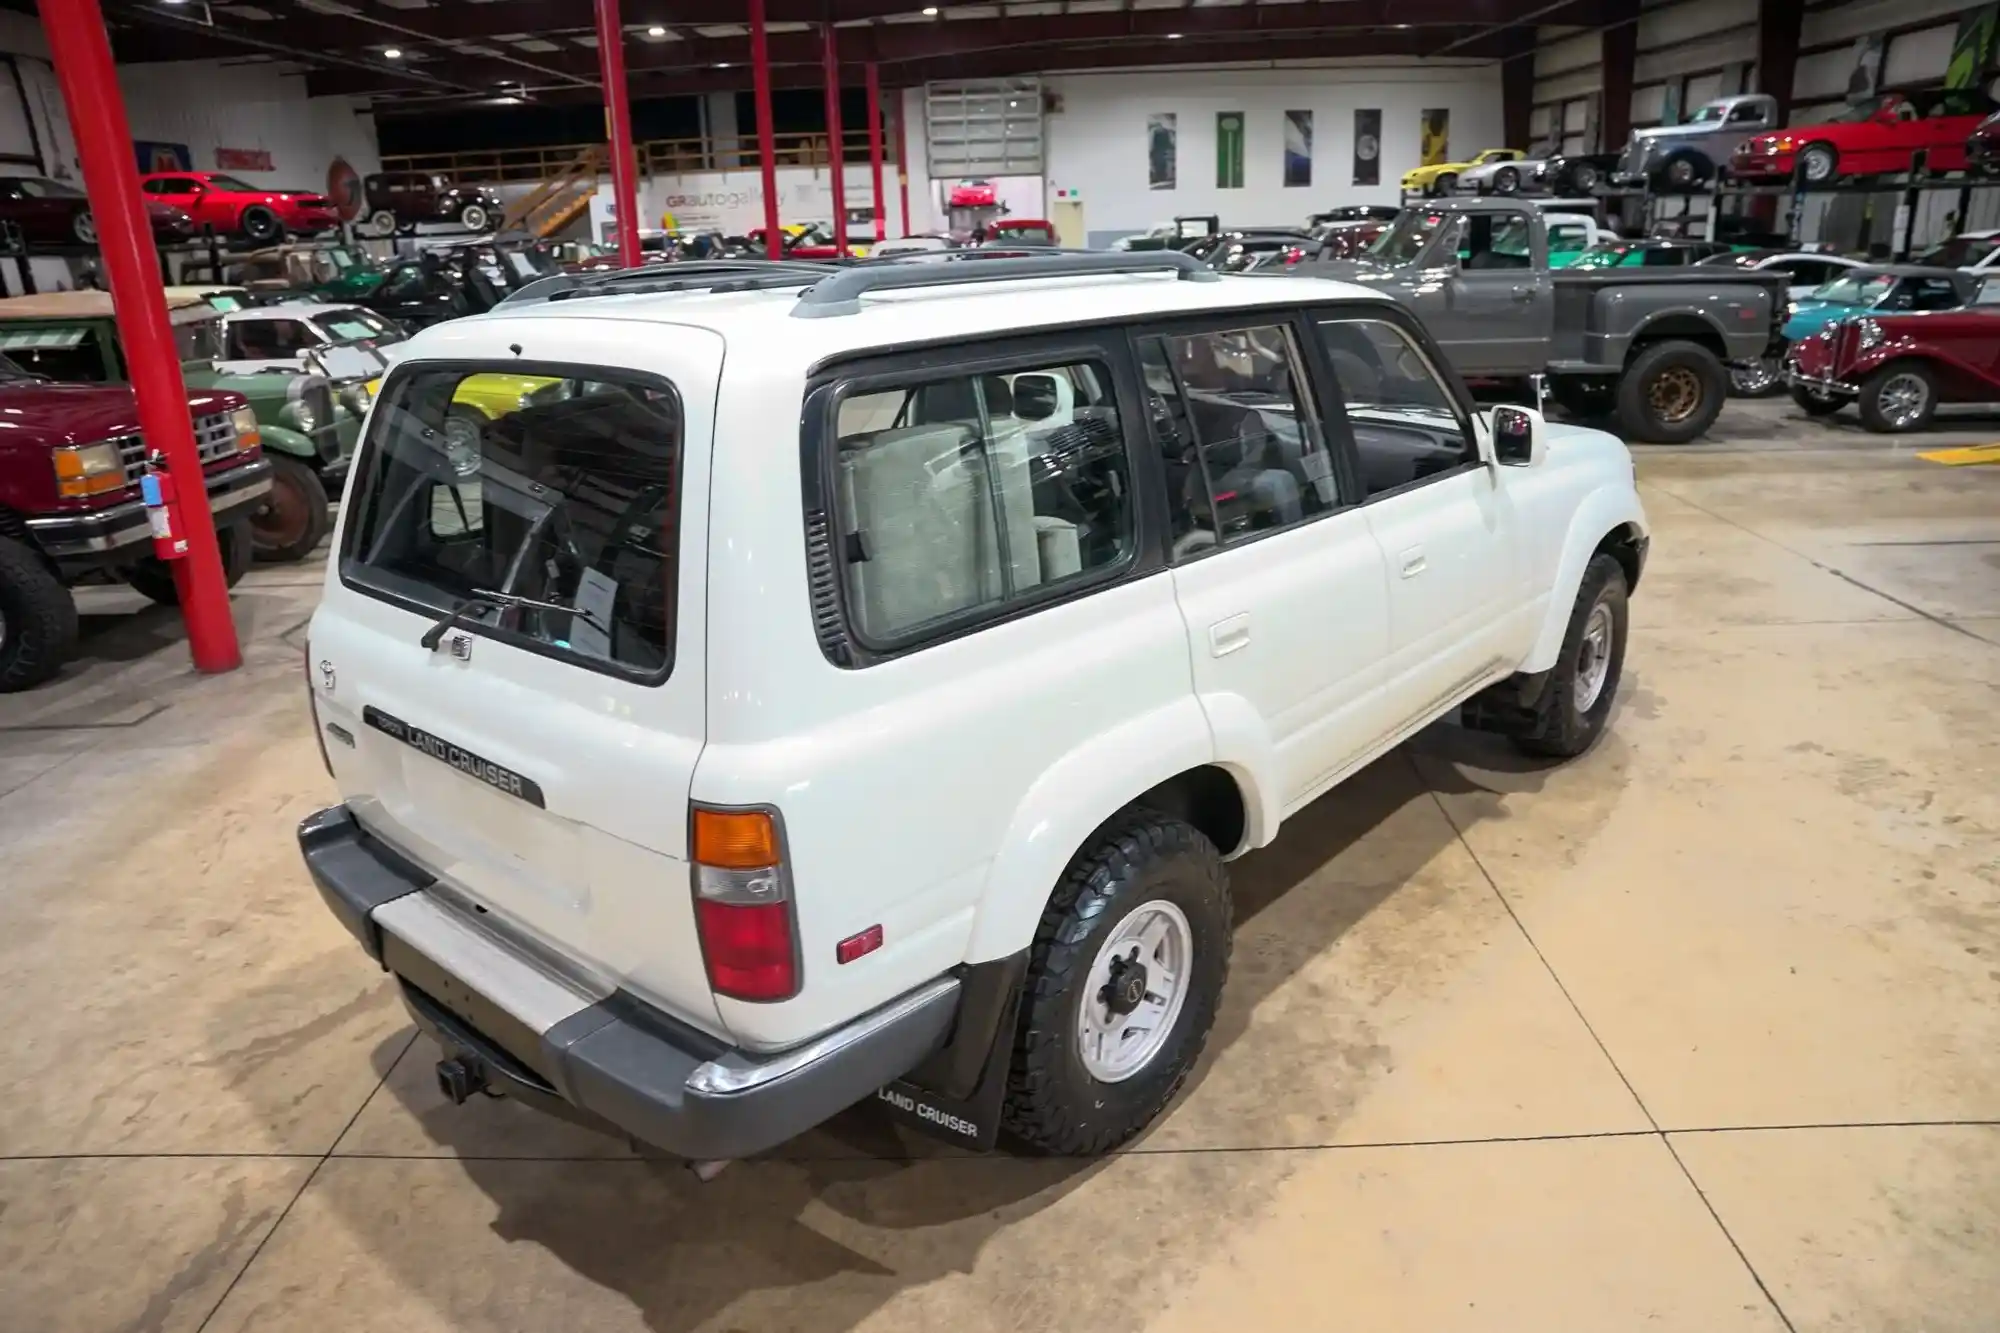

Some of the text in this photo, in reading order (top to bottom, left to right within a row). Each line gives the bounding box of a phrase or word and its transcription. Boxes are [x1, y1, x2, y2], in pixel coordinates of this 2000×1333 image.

[407, 727, 446, 759] LAND
[449, 748, 523, 797] CRUISER
[878, 1086, 978, 1137] LAND CRUISER
